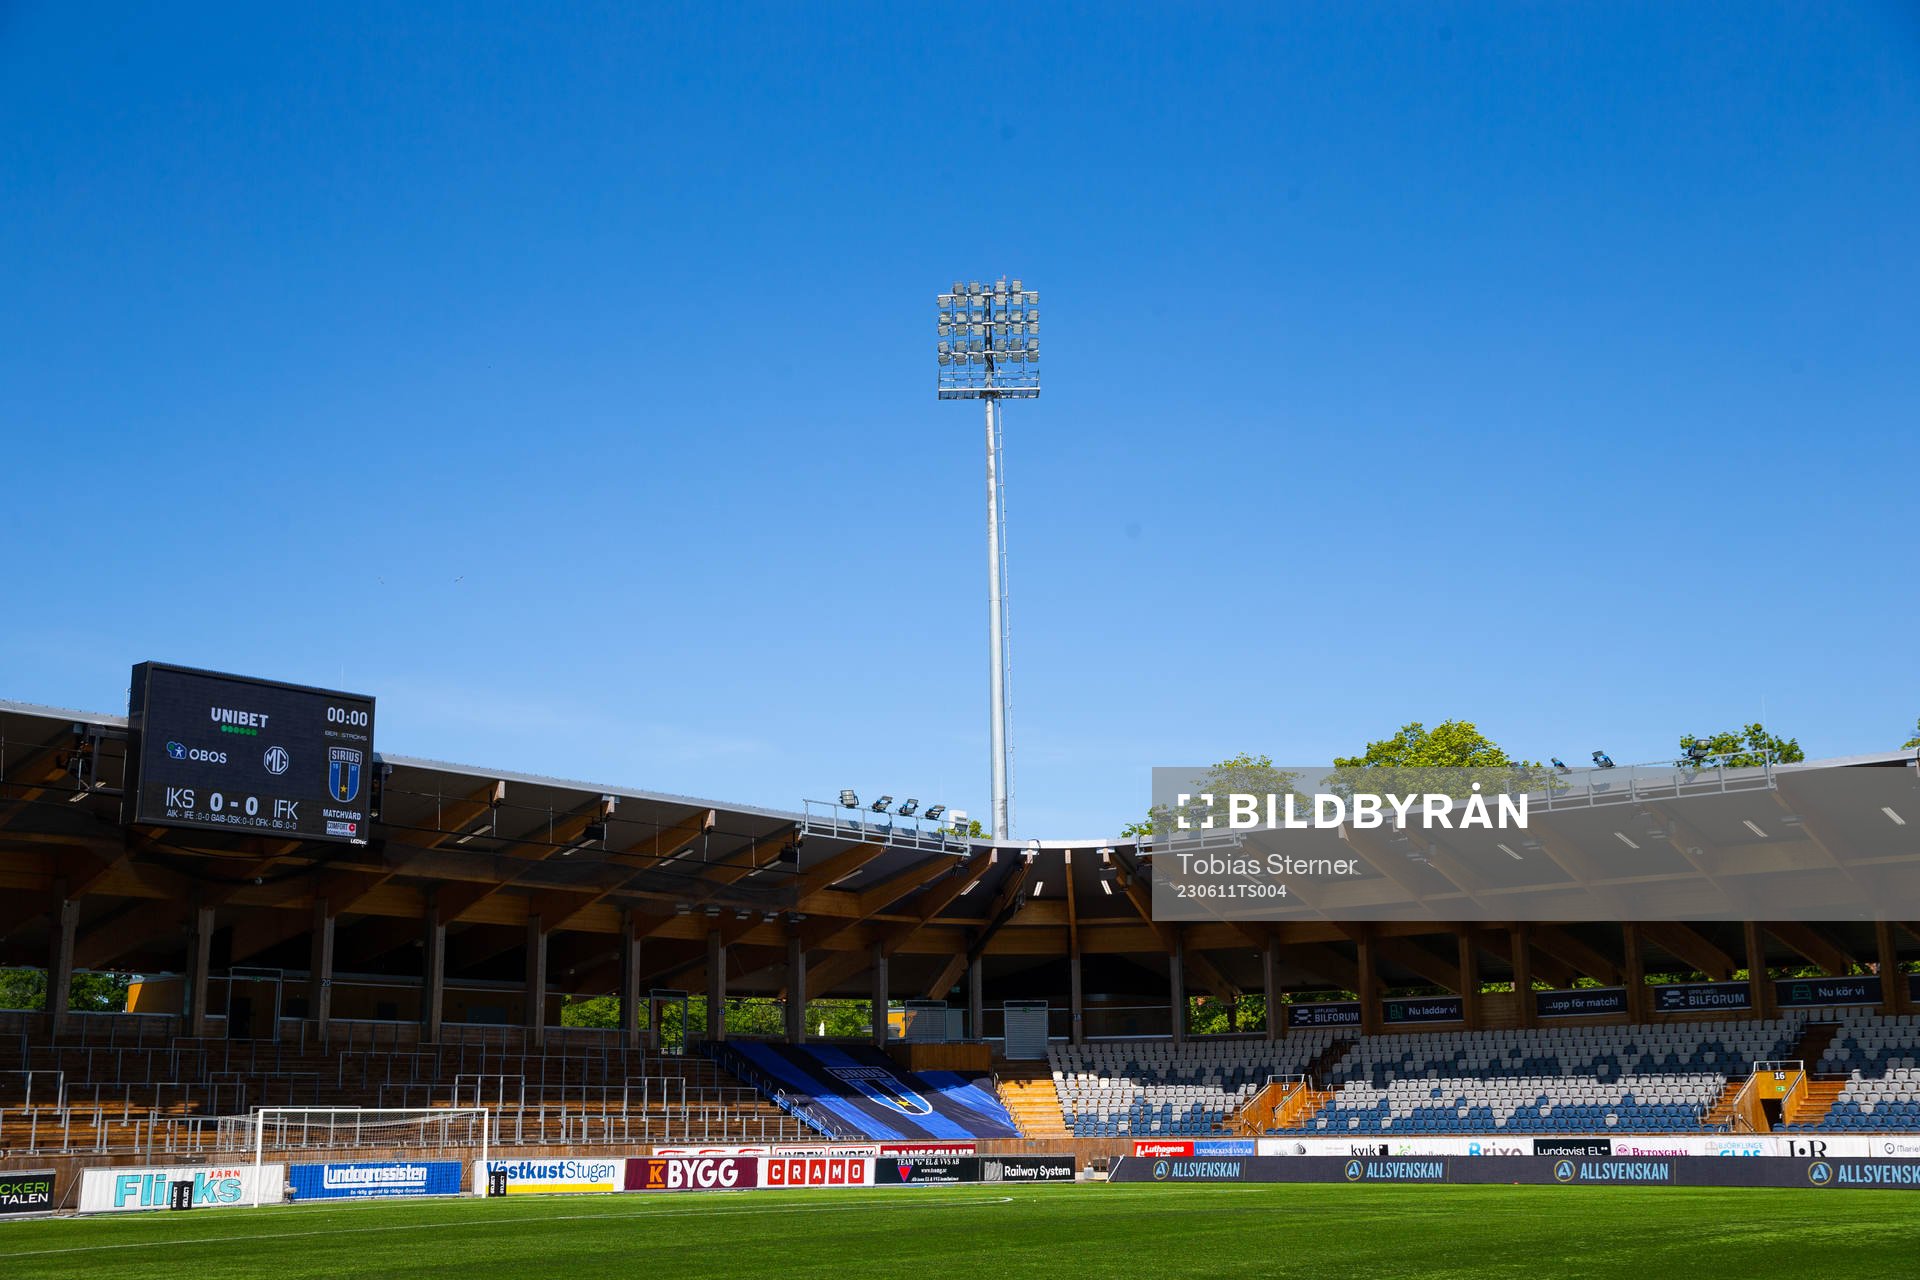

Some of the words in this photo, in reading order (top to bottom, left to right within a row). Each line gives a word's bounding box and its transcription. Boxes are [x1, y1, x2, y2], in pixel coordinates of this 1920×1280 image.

[210, 707, 269, 728] UNIBET
[327, 707, 368, 727] 00:00
[189, 748, 227, 763] OBOS
[266, 748, 287, 772] MG
[331, 750, 360, 763] SIRIUS
[166, 787, 195, 809] IKS
[210, 792, 223, 812] 0
[245, 797, 258, 816] 0
[273, 799, 299, 820] IFK
[1818, 987, 1834, 997] Nu
[1836, 985, 1852, 996] kör
[1853, 985, 1864, 995] vi
[1571, 998, 1586, 1008] för
[1587, 996, 1618, 1007] match!
[1689, 993, 1745, 1006] BILFORUM
[1314, 1012, 1359, 1023] BILFORUM
[1408, 1007, 1420, 1016] Nu
[1422, 1006, 1447, 1016] laddar
[1449, 1005, 1457, 1014] vi
[1774, 1071, 1785, 1080] 16
[1145, 1144, 1185, 1154] Luthagens
[897, 1158, 914, 1166] TEAM
[209, 1169, 241, 1179] JÄRN
[323, 1165, 427, 1189] Lundagrossisten
[770, 1164, 861, 1180] CRAMO
[1004, 1164, 1038, 1180] Railway
[1039, 1164, 1071, 1180] System
[1172, 1162, 1240, 1178] ALLSVENSKAN
[1366, 1162, 1443, 1179] ALLSVENSKAN
[1580, 1162, 1669, 1180] ALLSVENSKAN
[1, 1193, 49, 1205] TALEN
